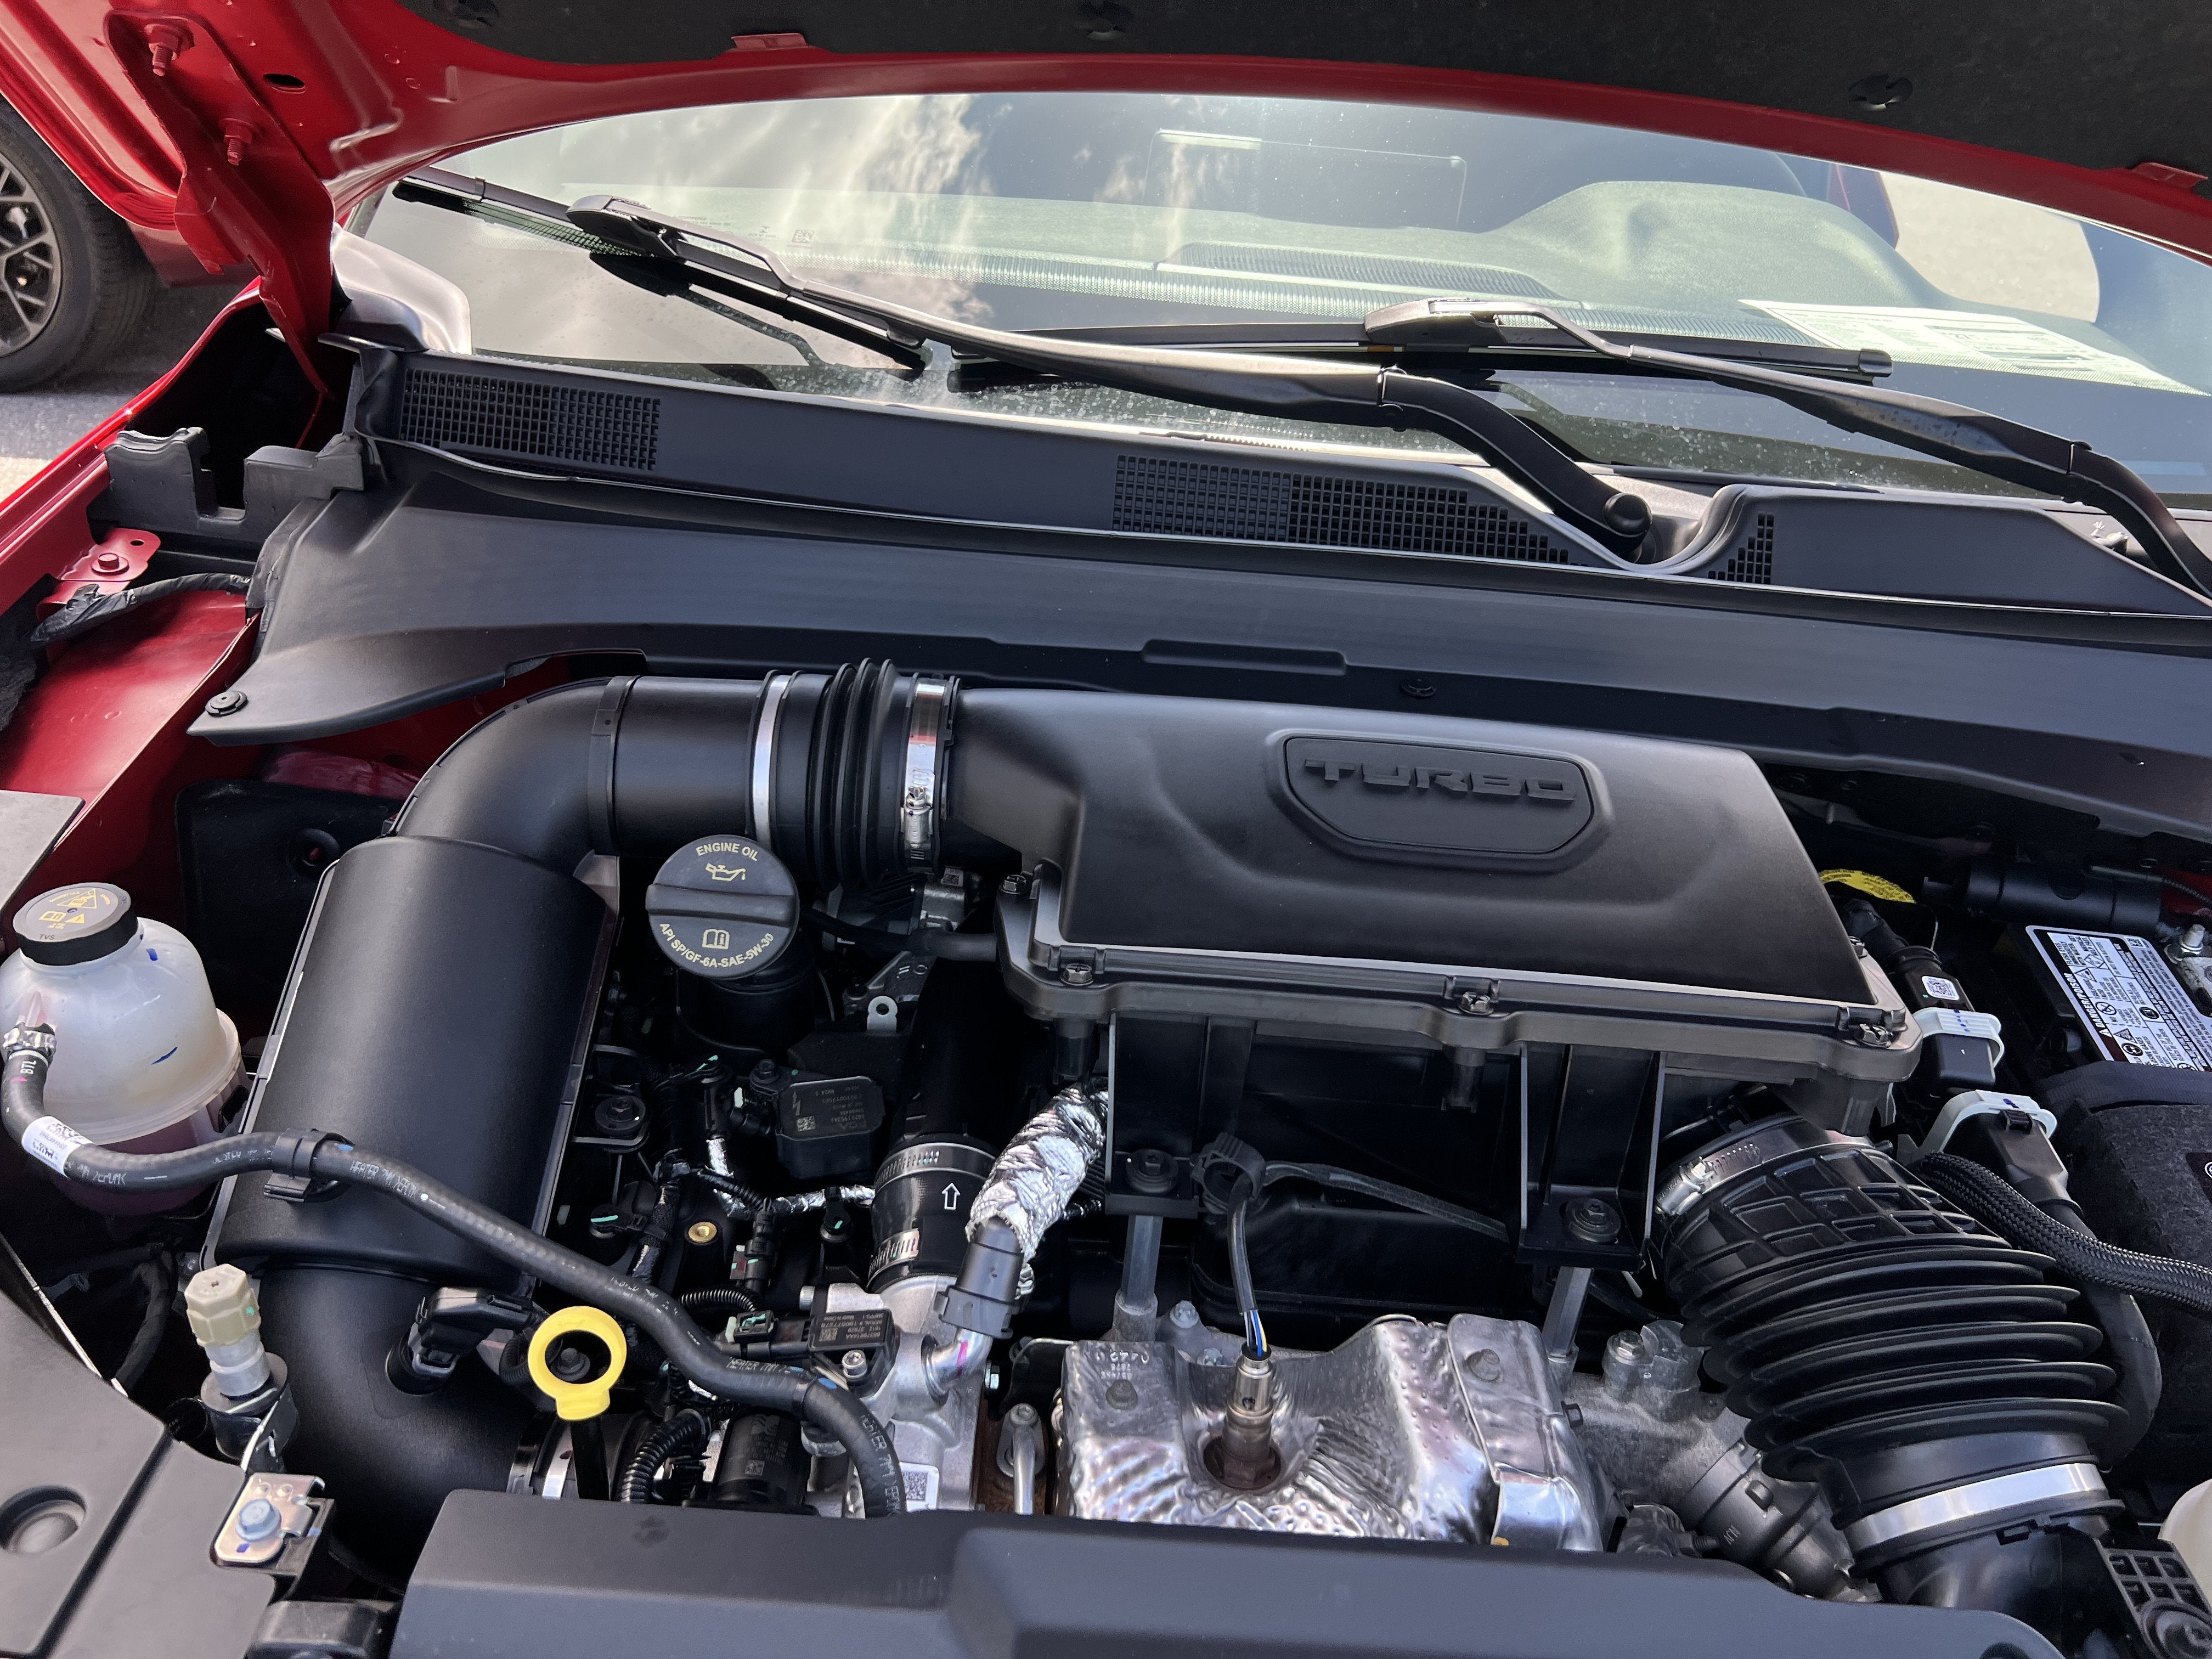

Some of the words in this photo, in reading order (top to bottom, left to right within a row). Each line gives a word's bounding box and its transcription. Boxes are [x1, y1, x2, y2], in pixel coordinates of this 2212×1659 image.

[1304, 759, 1576, 801] TURBO
[696, 842, 740, 856] ENGINE
[742, 846, 758, 861] OIL
[659, 923, 673, 941] API
[671, 933, 774, 968] SP/GF-6A-SAE-5W-30
[2063, 973, 2106, 1028] DANGER/POISON
[20, 1060, 37, 1075] BTL
[349, 1160, 380, 1180] HEATER
